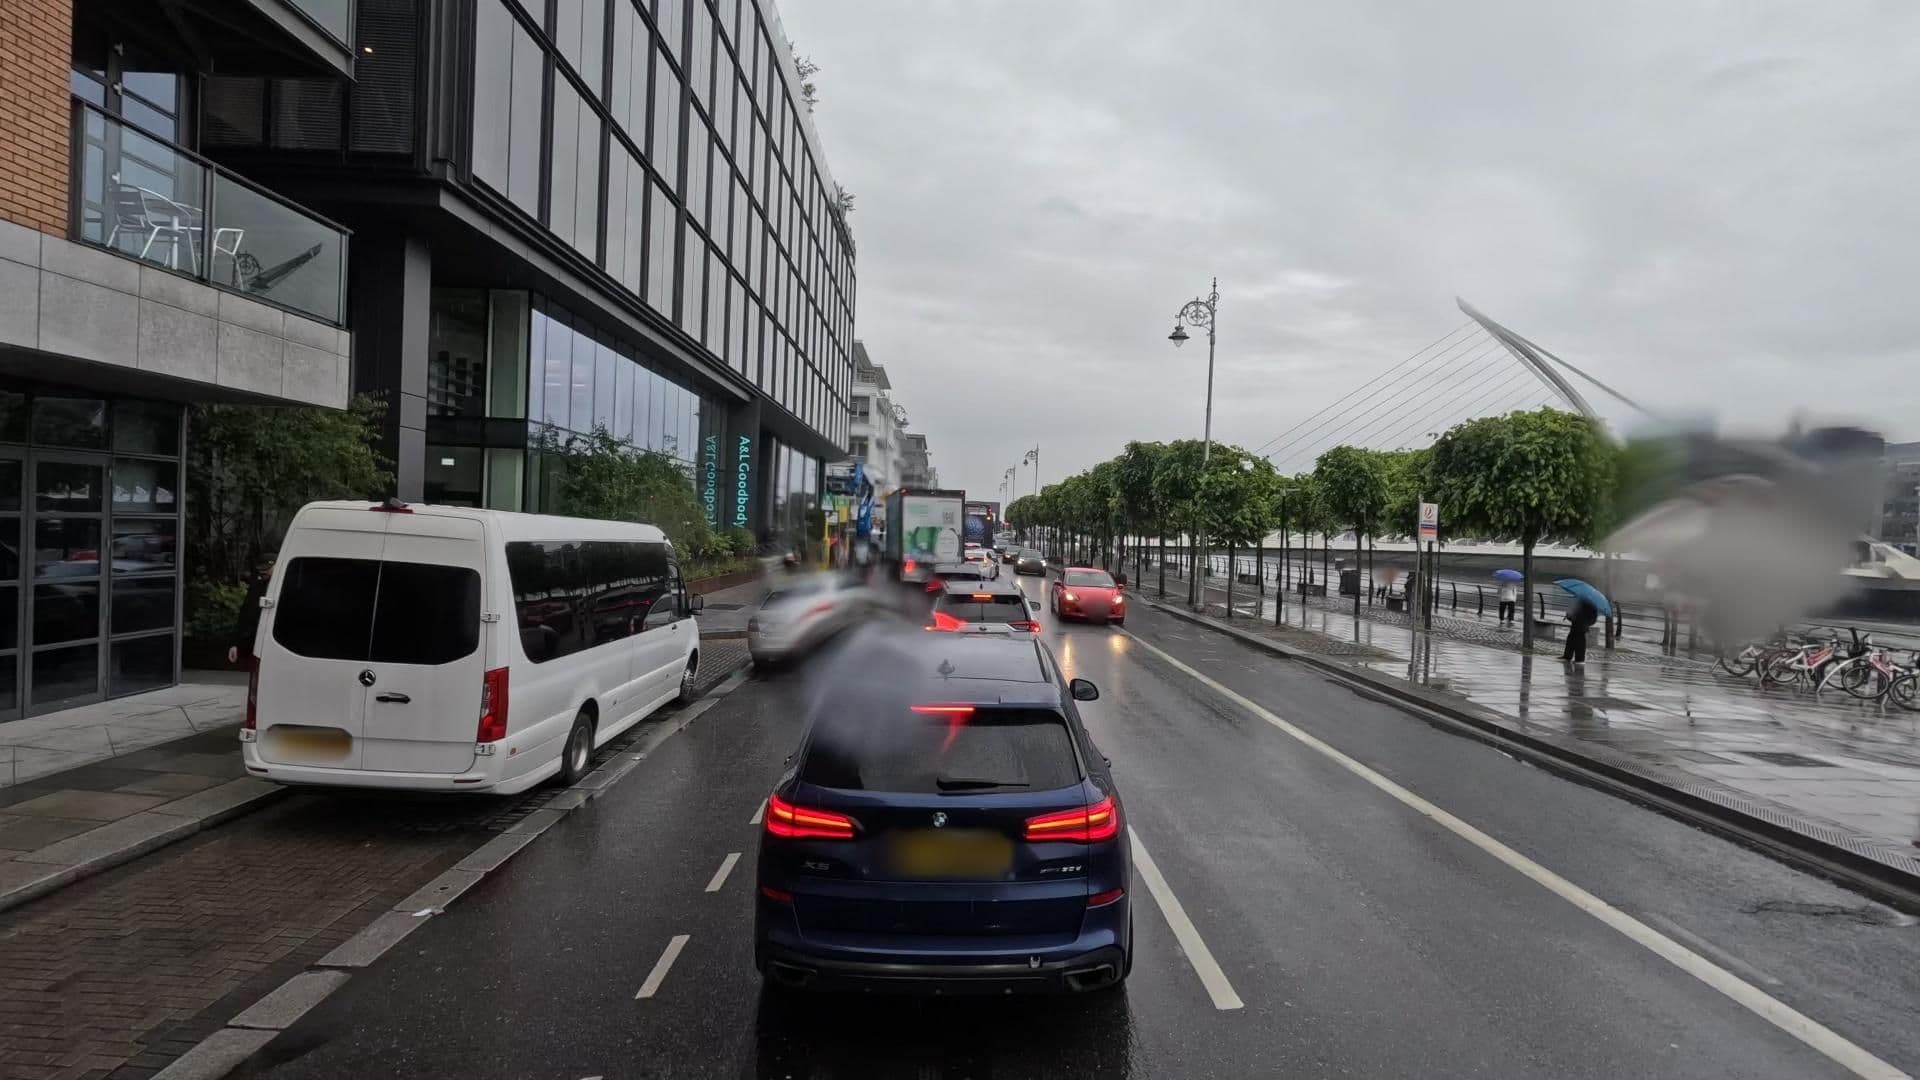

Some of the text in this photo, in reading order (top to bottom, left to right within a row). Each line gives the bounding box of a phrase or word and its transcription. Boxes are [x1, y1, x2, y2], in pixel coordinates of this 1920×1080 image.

[732, 436, 751, 529] A&L Goodbody
[802, 861, 831, 872] X5
